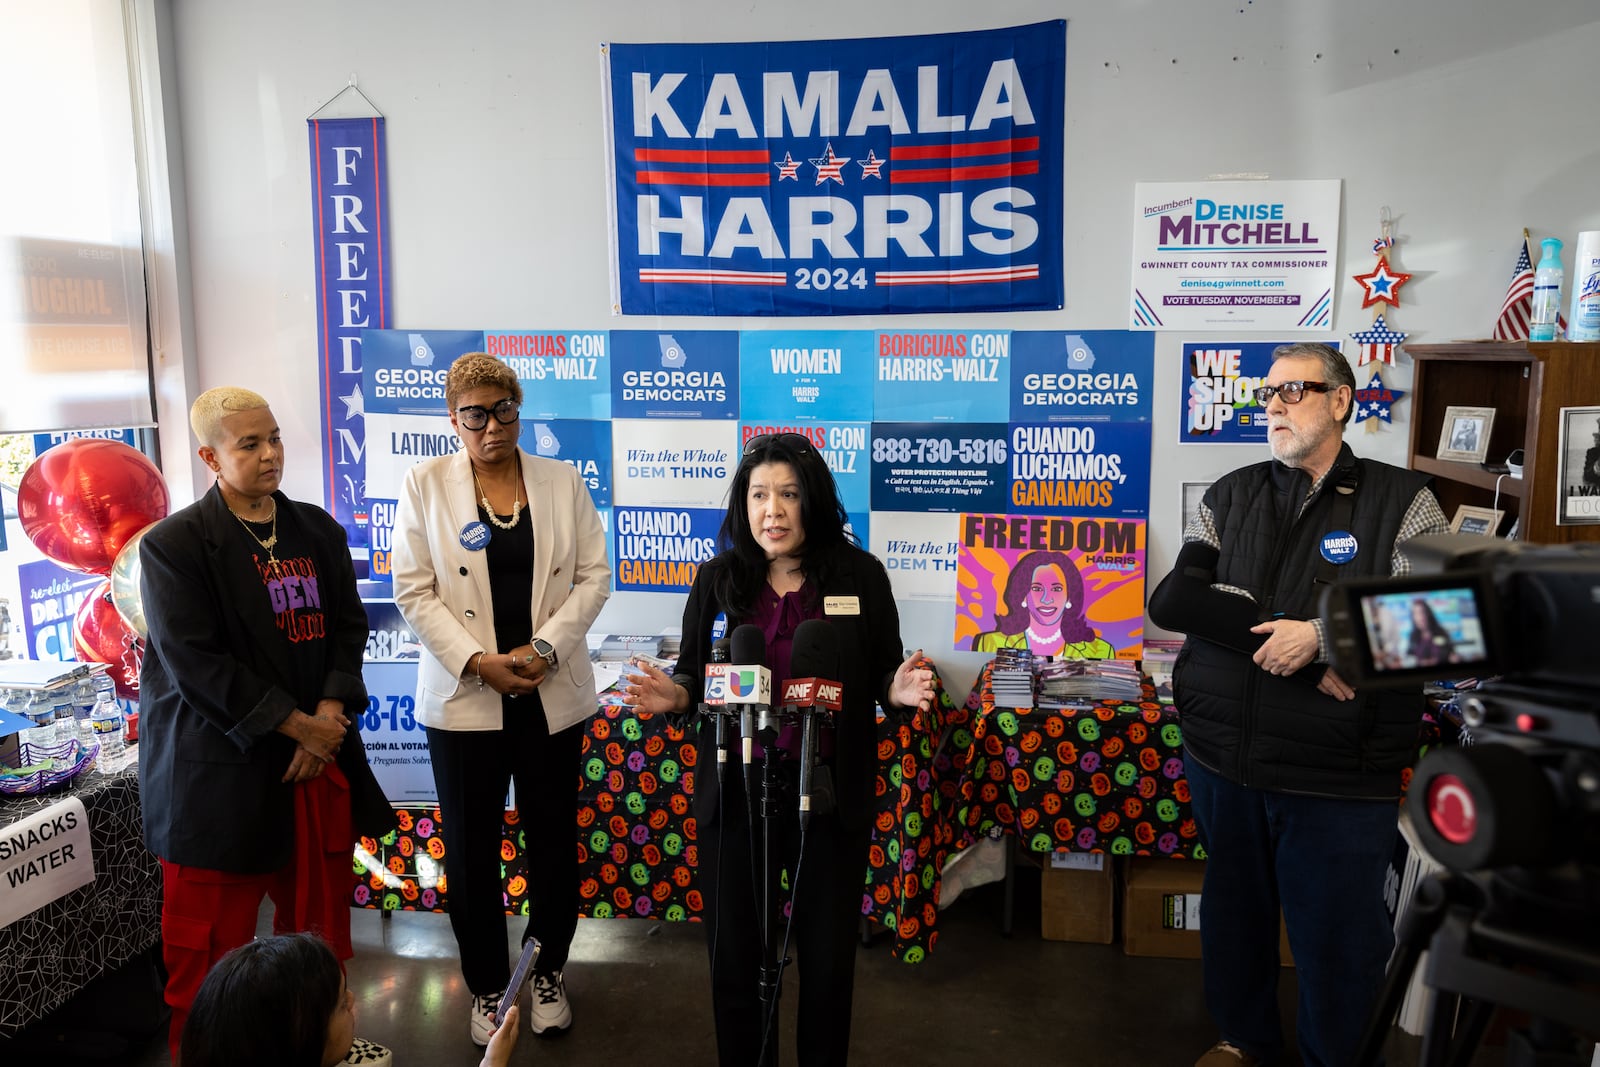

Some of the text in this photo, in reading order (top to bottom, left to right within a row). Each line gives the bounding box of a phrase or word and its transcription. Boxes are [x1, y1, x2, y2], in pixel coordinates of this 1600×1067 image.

[631, 58, 1036, 139] KAMALA
[1144, 197, 1193, 215] Incumbent
[1195, 199, 1284, 220] DENISE
[636, 187, 1039, 259] HARRIS
[1158, 216, 1318, 245] MITCHELL
[1141, 261, 1188, 269] GWINNETT
[1252, 260, 1328, 268] COMMISSIONER
[794, 268, 868, 290] 2024
[1181, 280, 1284, 289] denise4gwinnett.com
[23, 276, 113, 315] UGHAL
[1166, 296, 1190, 304] VOTE
[1234, 296, 1286, 304] NOVEMBER
[487, 334, 604, 357] BORICUAS CON
[878, 334, 1008, 358] BORICUAS CON
[770, 348, 841, 374] WOMEN
[878, 358, 998, 382] HARRIS-WALZ
[1194, 350, 1242, 376] WE
[375, 368, 447, 384] GEORG
[622, 370, 726, 387] GEORGIA
[1023, 373, 1138, 390] GEORGIA
[376, 386, 446, 398] DEMOCR
[623, 388, 726, 402] DEMOCRATS
[792, 387, 820, 397] HARRIS
[1023, 392, 1138, 406] DEMOCRATS
[1194, 404, 1234, 430] UP
[392, 432, 459, 456] LATINOS
[830, 427, 865, 450] CON
[1012, 426, 1095, 454] CUANDO
[626, 450, 728, 463] Win the Whole
[872, 438, 1007, 464] 888-730-5816
[628, 466, 726, 479] DEM THING
[1012, 454, 1127, 485] LUCHAMOS,
[1012, 480, 1113, 508] GANAMOS
[462, 524, 486, 542] HARRIS
[618, 510, 692, 536] CUANDO
[964, 516, 1136, 554] FREEDOM
[1324, 538, 1353, 549] HARRIS
[887, 540, 917, 554] Win
[920, 542, 942, 554] the
[1330, 547, 1350, 555] WALZ
[887, 558, 927, 570] DEM
[1086, 556, 1136, 564] HARRIS
[619, 560, 698, 586] GANAMO
[30, 577, 73, 599] re-elect
[267, 576, 320, 614] GEN
[760, 677, 770, 695] 34
[784, 683, 813, 699] ANF
[816, 684, 841, 700] ANF
[389, 743, 400, 751] AL
[400, 742, 429, 751] VOTAN
[374, 756, 411, 767] Preguntas
[0, 811, 78, 861] SNACKS
[7, 844, 76, 889] WATER
